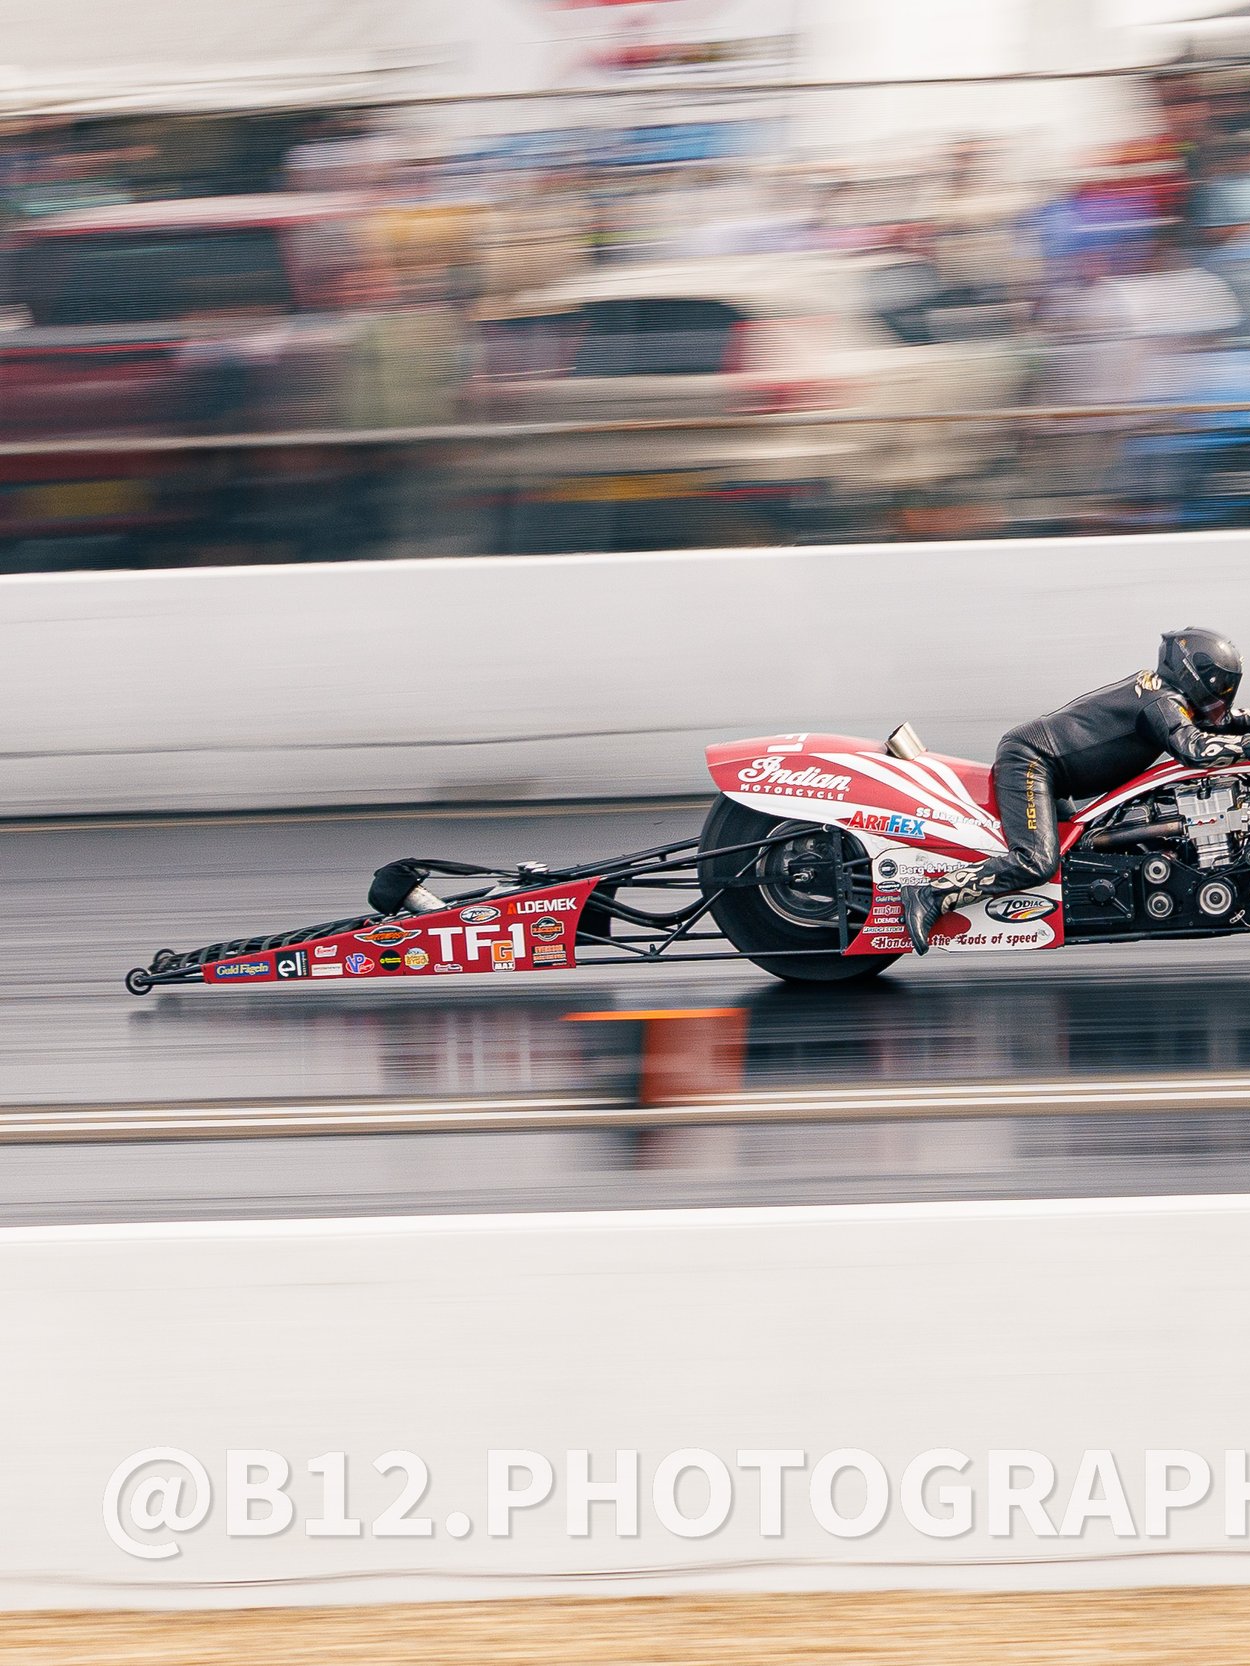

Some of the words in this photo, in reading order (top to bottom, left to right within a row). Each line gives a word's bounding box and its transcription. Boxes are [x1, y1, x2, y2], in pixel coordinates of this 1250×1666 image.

[737, 756, 852, 791] Indian
[740, 783, 844, 801] MOTORCYCLE
[849, 811, 926, 836] ARTFEX
[900, 864, 925, 876] Berg
[926, 863, 936, 873] &
[507, 898, 578, 915] ALDEMEK
[1001, 899, 1045, 917] ZODIAC
[428, 923, 527, 962] TF1
[933, 935, 951, 946] the
[991, 933, 1003, 944] of
[1007, 932, 1038, 947] speed
